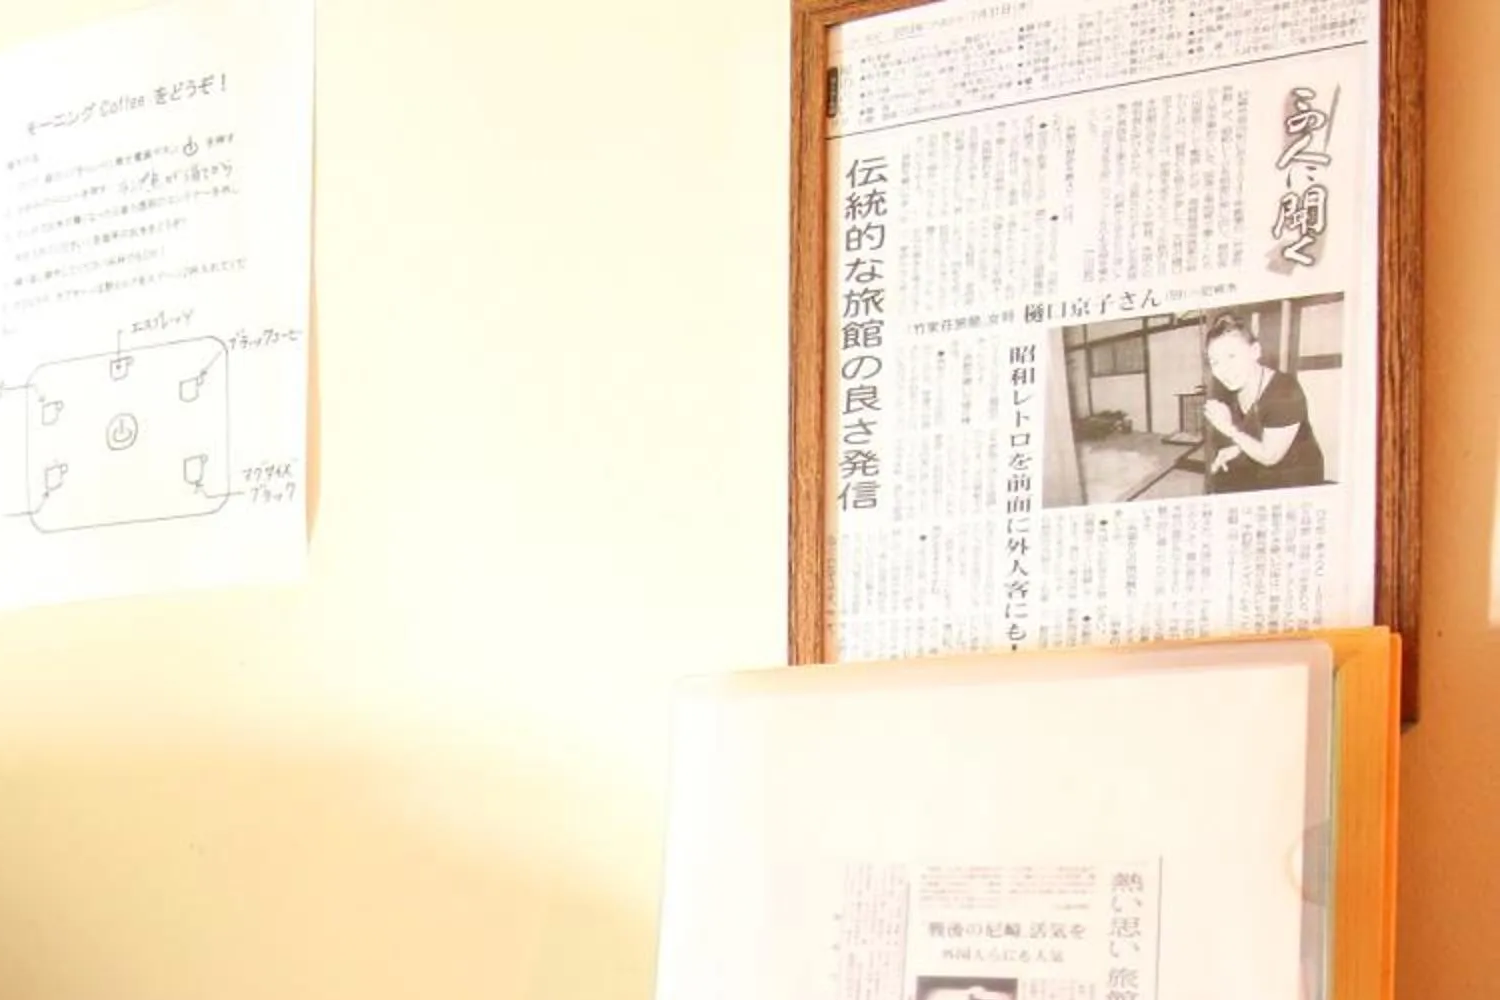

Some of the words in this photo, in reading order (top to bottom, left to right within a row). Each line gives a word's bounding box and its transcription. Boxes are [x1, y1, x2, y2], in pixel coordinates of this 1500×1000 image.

[837, 157, 889, 511] 伝統的な旅館の良さ発信
